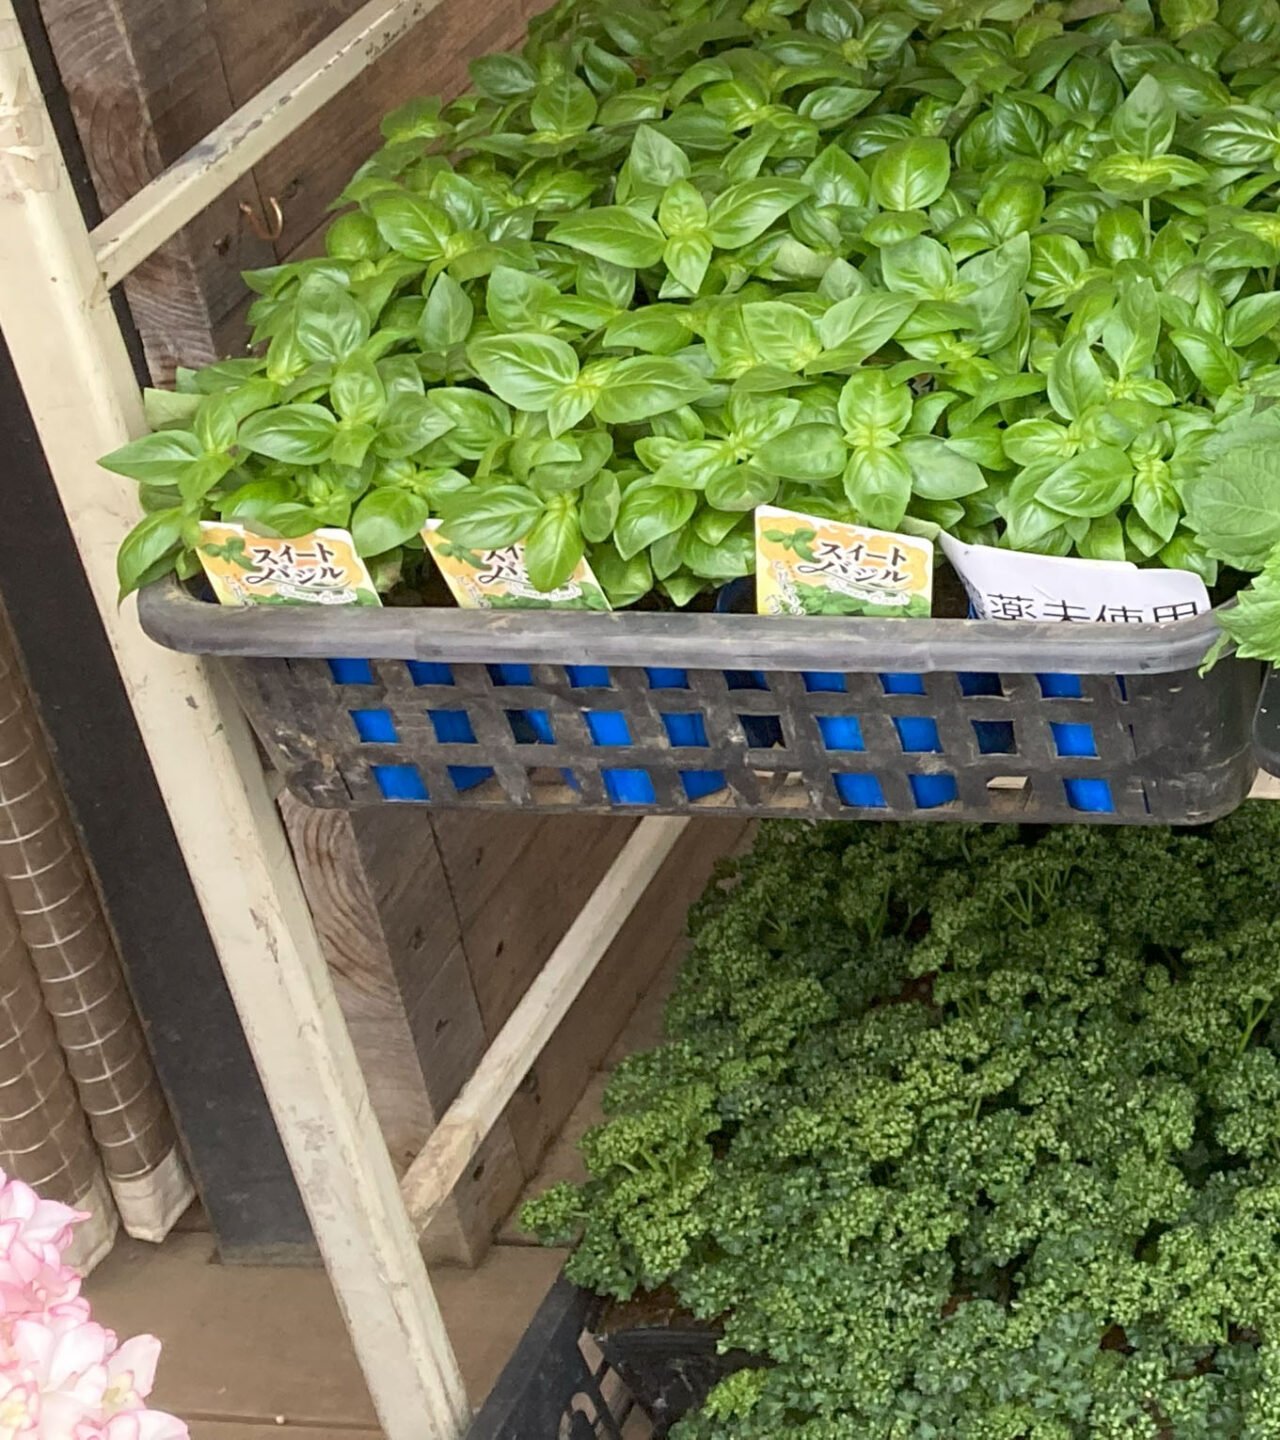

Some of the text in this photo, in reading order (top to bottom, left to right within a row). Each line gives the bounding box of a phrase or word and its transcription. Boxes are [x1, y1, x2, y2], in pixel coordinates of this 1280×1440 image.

[253, 542, 334, 565] スイート
[819, 541, 907, 567] スイート
[246, 566, 345, 586] バジル
[798, 562, 908, 583] バジル
